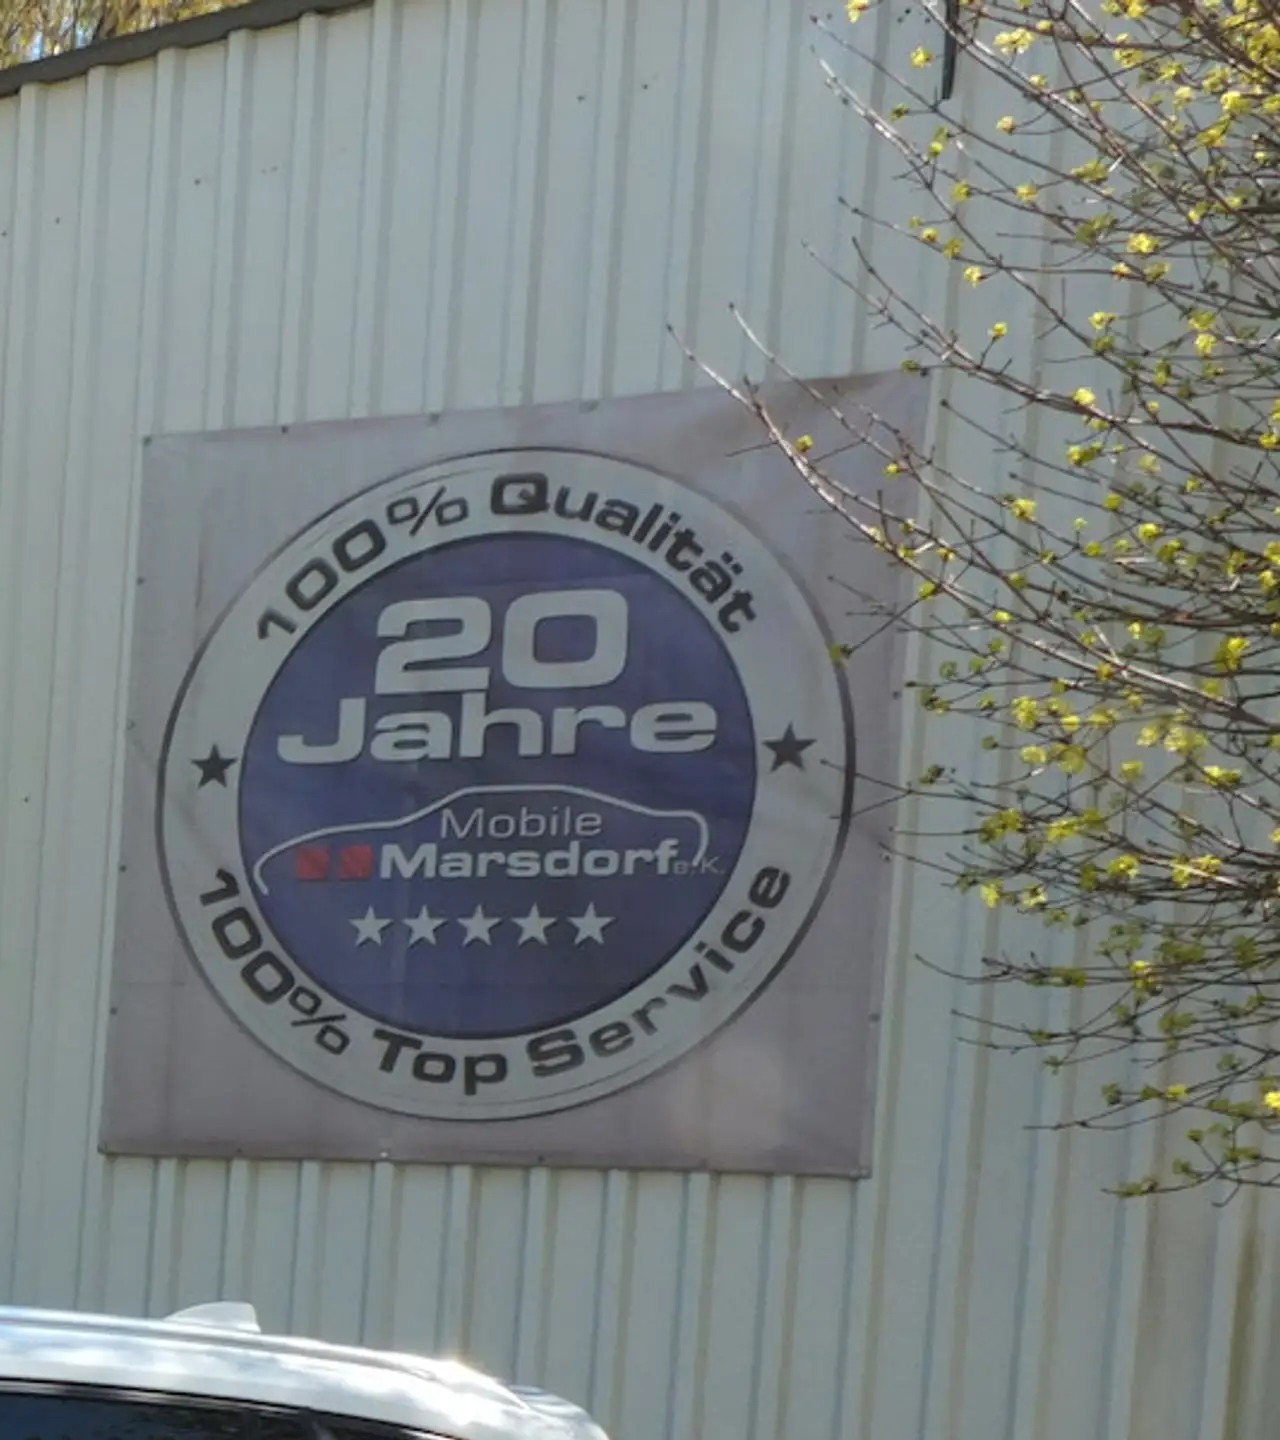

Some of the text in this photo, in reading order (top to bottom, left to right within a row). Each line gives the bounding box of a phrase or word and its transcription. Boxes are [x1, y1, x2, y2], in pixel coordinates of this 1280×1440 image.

[256, 472, 757, 640] 100% Qualität
[374, 588, 630, 695] 20
[276, 690, 718, 765] Jahre
[378, 837, 680, 880] Marsdorf
[440, 806, 603, 839] Mobile
[199, 866, 792, 1097] 100% Top Service
